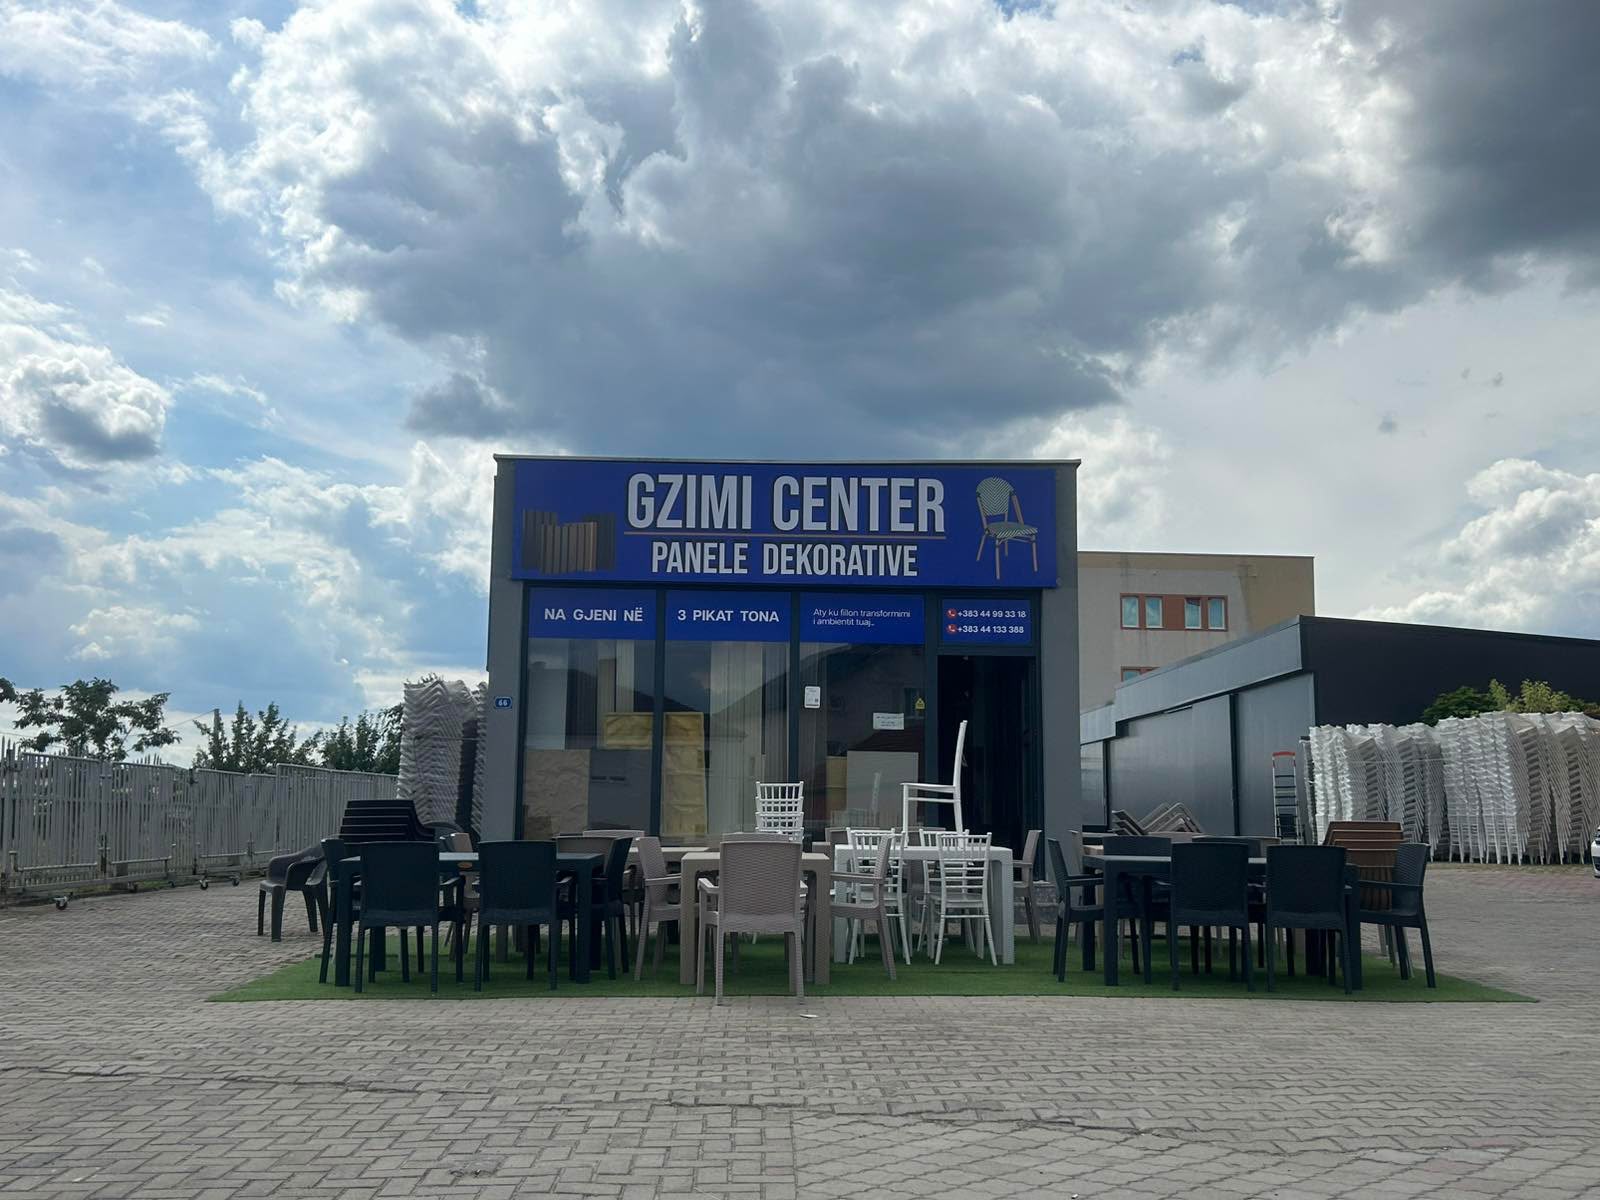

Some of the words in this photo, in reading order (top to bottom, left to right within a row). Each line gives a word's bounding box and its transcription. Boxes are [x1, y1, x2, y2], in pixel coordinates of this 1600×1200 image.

[627, 473, 752, 530] GZIMI
[773, 475, 945, 533] CENTER
[652, 541, 748, 575] PANELE
[763, 543, 918, 578] DEKORATIVE
[544, 608, 566, 620] NA
[573, 608, 617, 621] GJENI
[623, 607, 643, 622] NË
[677, 609, 687, 621] 3
[693, 609, 734, 622] PIKAT
[740, 610, 780, 622] TONA
[813, 608, 827, 618] Aty
[828, 608, 839, 617] ku
[860, 609, 911, 618] transformimi
[957, 609, 979, 618] +383
[980, 610, 991, 618] 44
[992, 610, 1003, 618] 99
[1004, 610, 1016, 618] 33
[1017, 610, 1027, 618] 18
[817, 617, 854, 626] ambientit
[957, 625, 979, 633] +383
[980, 625, 991, 633] 44
[992, 625, 1007, 634] 133
[1008, 626, 1024, 634] 388
[498, 698, 508, 707] 66
